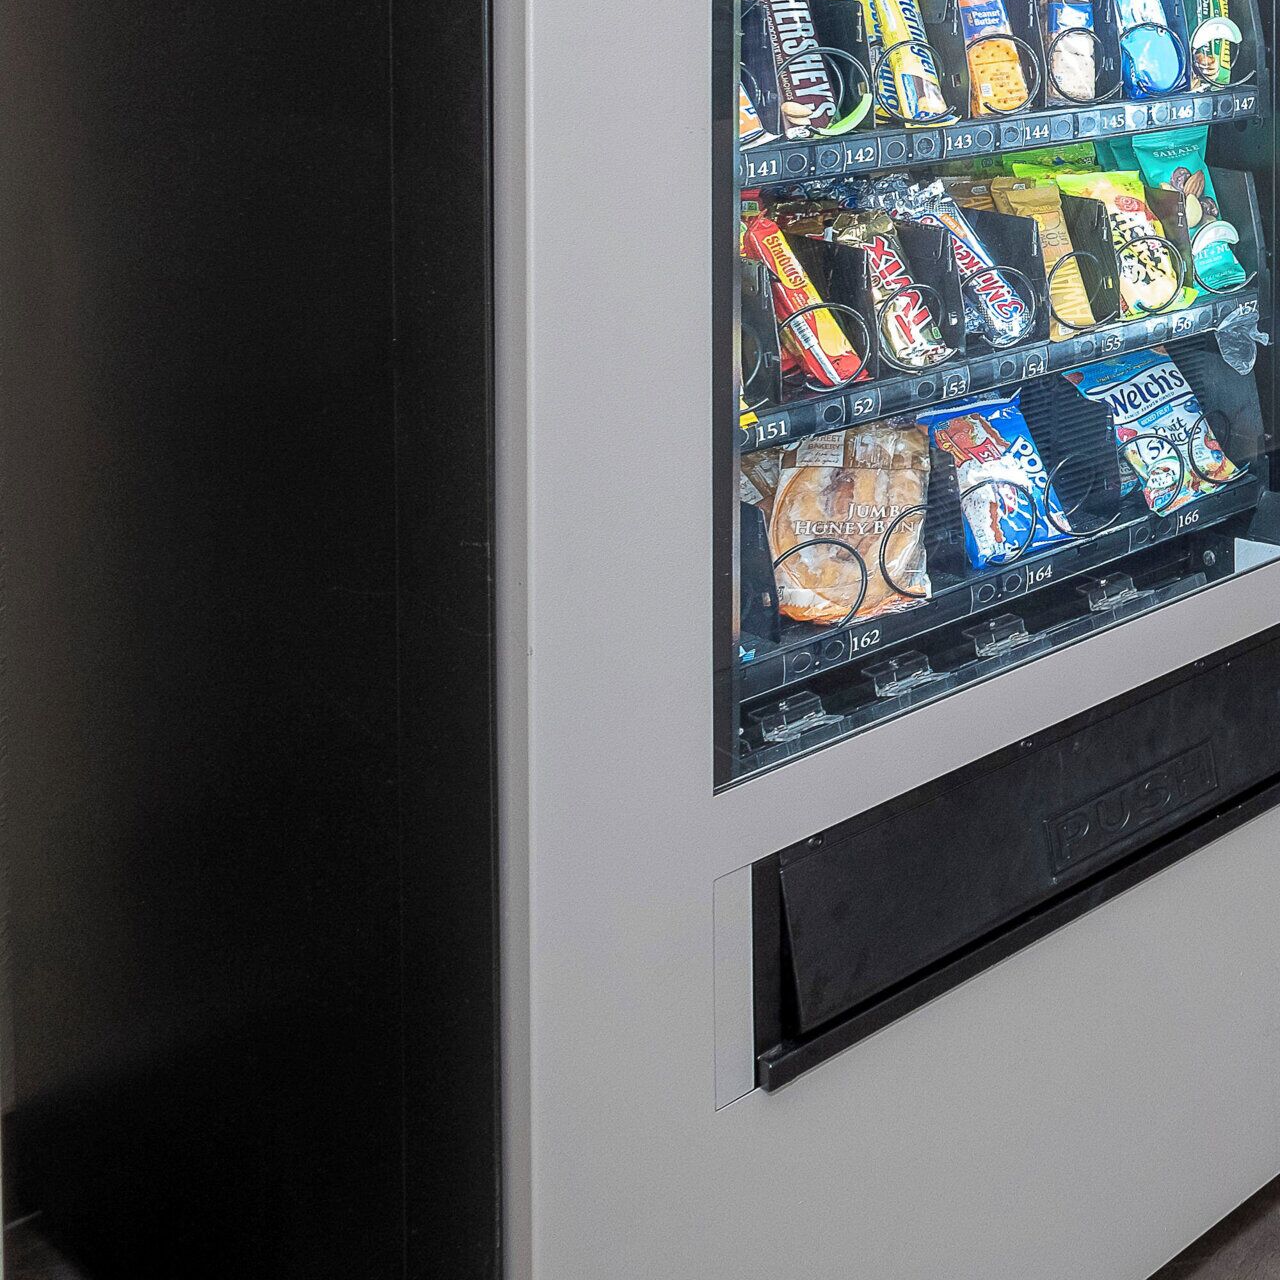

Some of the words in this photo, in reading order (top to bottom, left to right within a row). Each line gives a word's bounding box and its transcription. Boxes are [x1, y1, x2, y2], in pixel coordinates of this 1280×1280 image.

[972, 10, 1000, 19] Peanut
[748, 159, 778, 178] 141
[846, 147, 874, 165] 142
[946, 135, 973, 151] 143
[1025, 125, 1049, 140] 144
[1102, 115, 1125, 129] 145
[1171, 105, 1192, 119] 146
[1234, 97, 1255, 111] 147
[1152, 144, 1200, 158] SAHALE
[764, 233, 807, 291] Starburst
[862, 235, 932, 345] TWIX
[997, 300, 1024, 316] 3
[757, 420, 788, 443] 151
[854, 398, 875, 417] 52
[941, 382, 967, 399] 153
[1022, 362, 1045, 380] 154
[1238, 300, 1258, 317] 157
[1101, 369, 1184, 417] Welch's
[810, 434, 842, 442] TREET
[794, 520, 868, 535] HONEY
[874, 520, 915, 535] BUN
[852, 629, 881, 651] 162
[1029, 564, 1053, 585] 164
[1179, 510, 1200, 528] 166
[1057, 753, 1212, 860] PUSH
